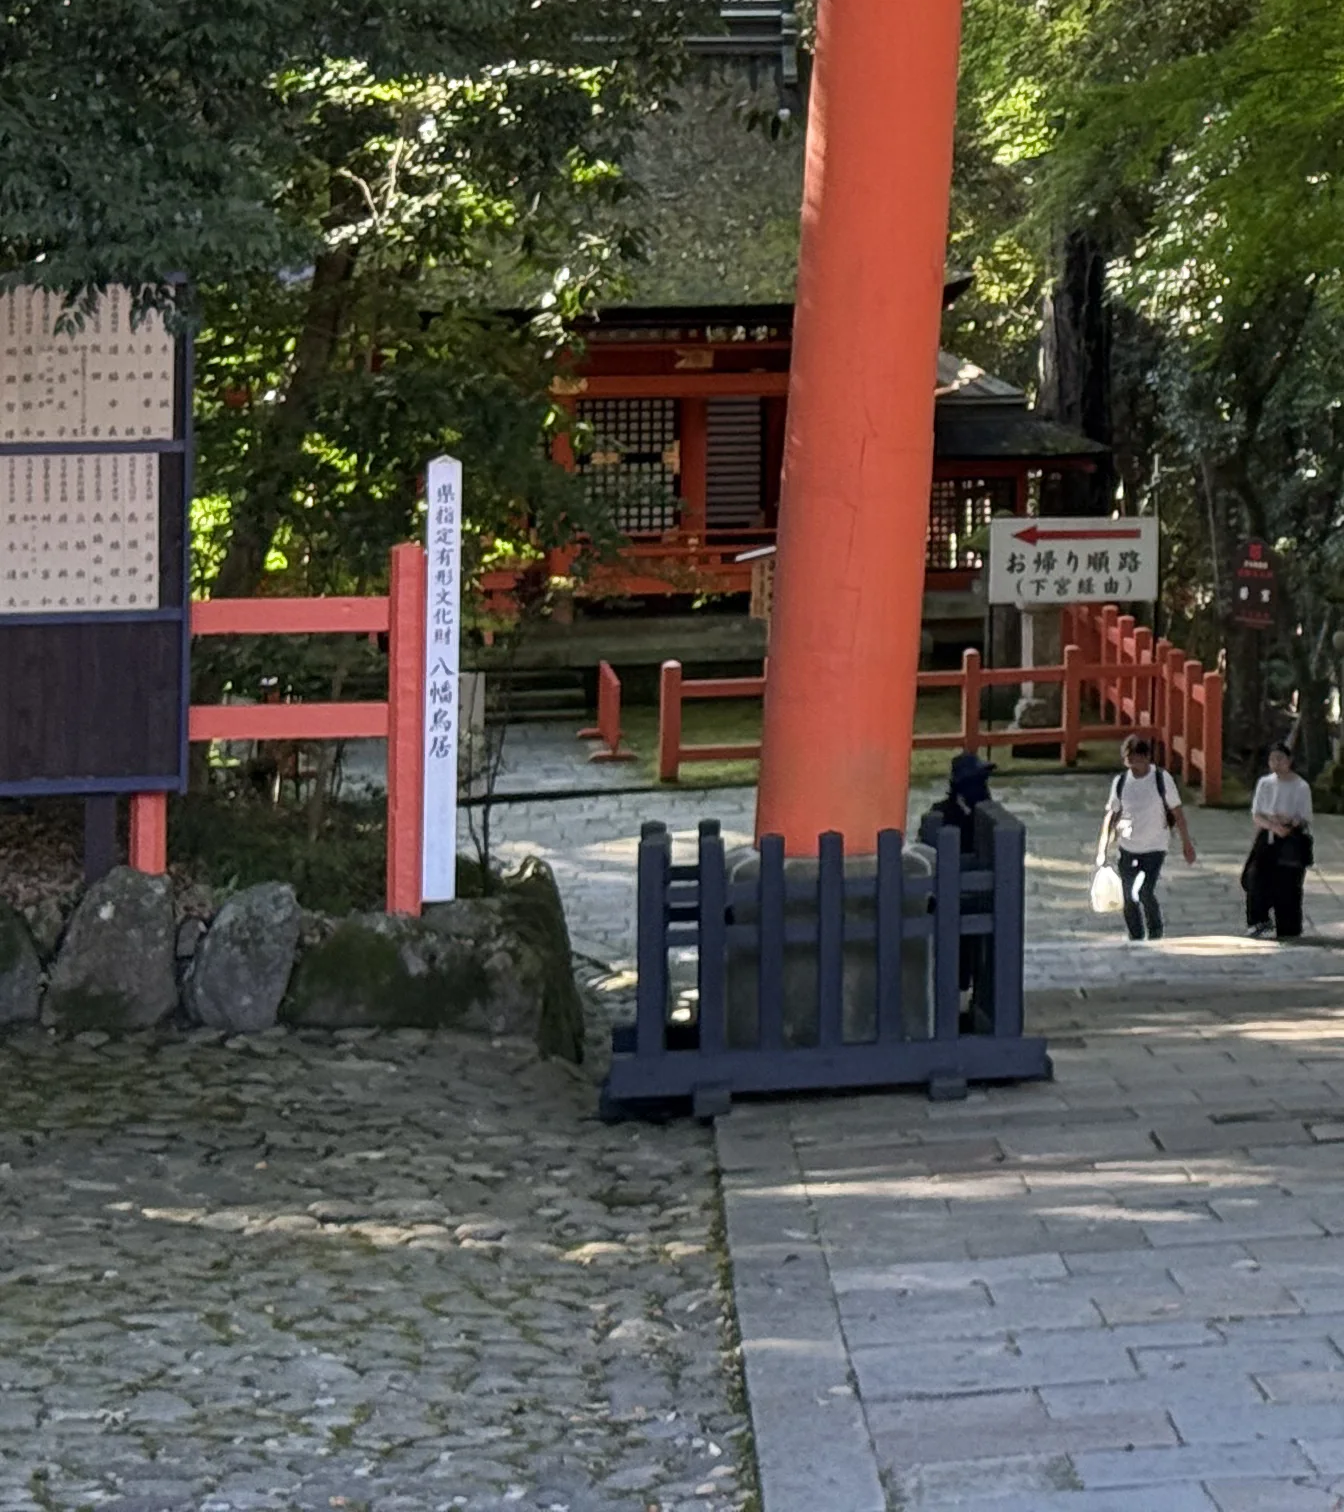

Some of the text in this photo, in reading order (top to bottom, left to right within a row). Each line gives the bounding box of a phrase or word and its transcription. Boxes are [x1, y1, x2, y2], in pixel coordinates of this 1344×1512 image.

[429, 482, 455, 759] 県指定有形文化財 八幡鳥居
[1006, 550, 1142, 574] お帰り順路
